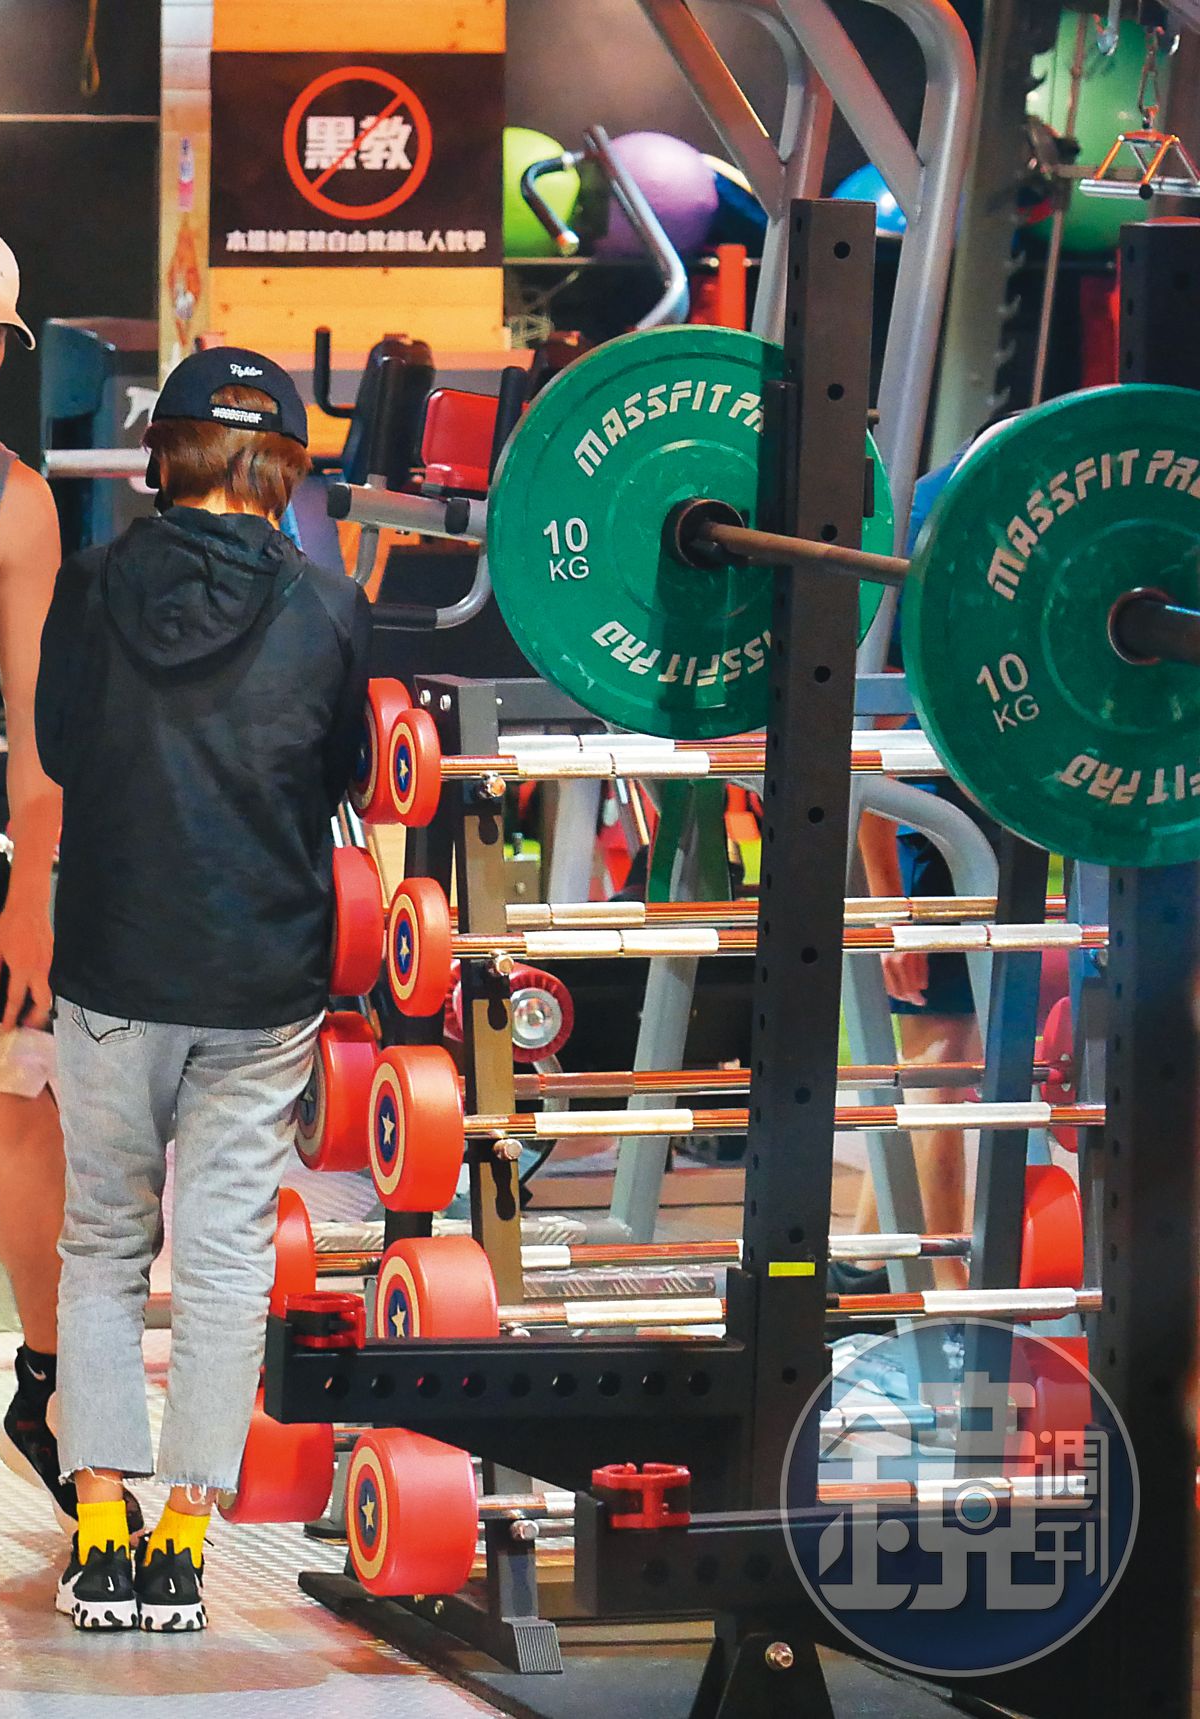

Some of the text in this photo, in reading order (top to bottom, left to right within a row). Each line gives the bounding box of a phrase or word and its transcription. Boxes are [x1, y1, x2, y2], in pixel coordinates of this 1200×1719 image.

[573, 379, 765, 478] MASSFIT PR
[543, 517, 589, 555] 10
[986, 448, 1141, 601] MASSFIT
[548, 556, 590, 582] KG
[590, 620, 771, 687] SSFIT PRO
[976, 652, 1029, 702] 10
[992, 694, 1040, 733] KG
[1060, 753, 1142, 806] PRO
